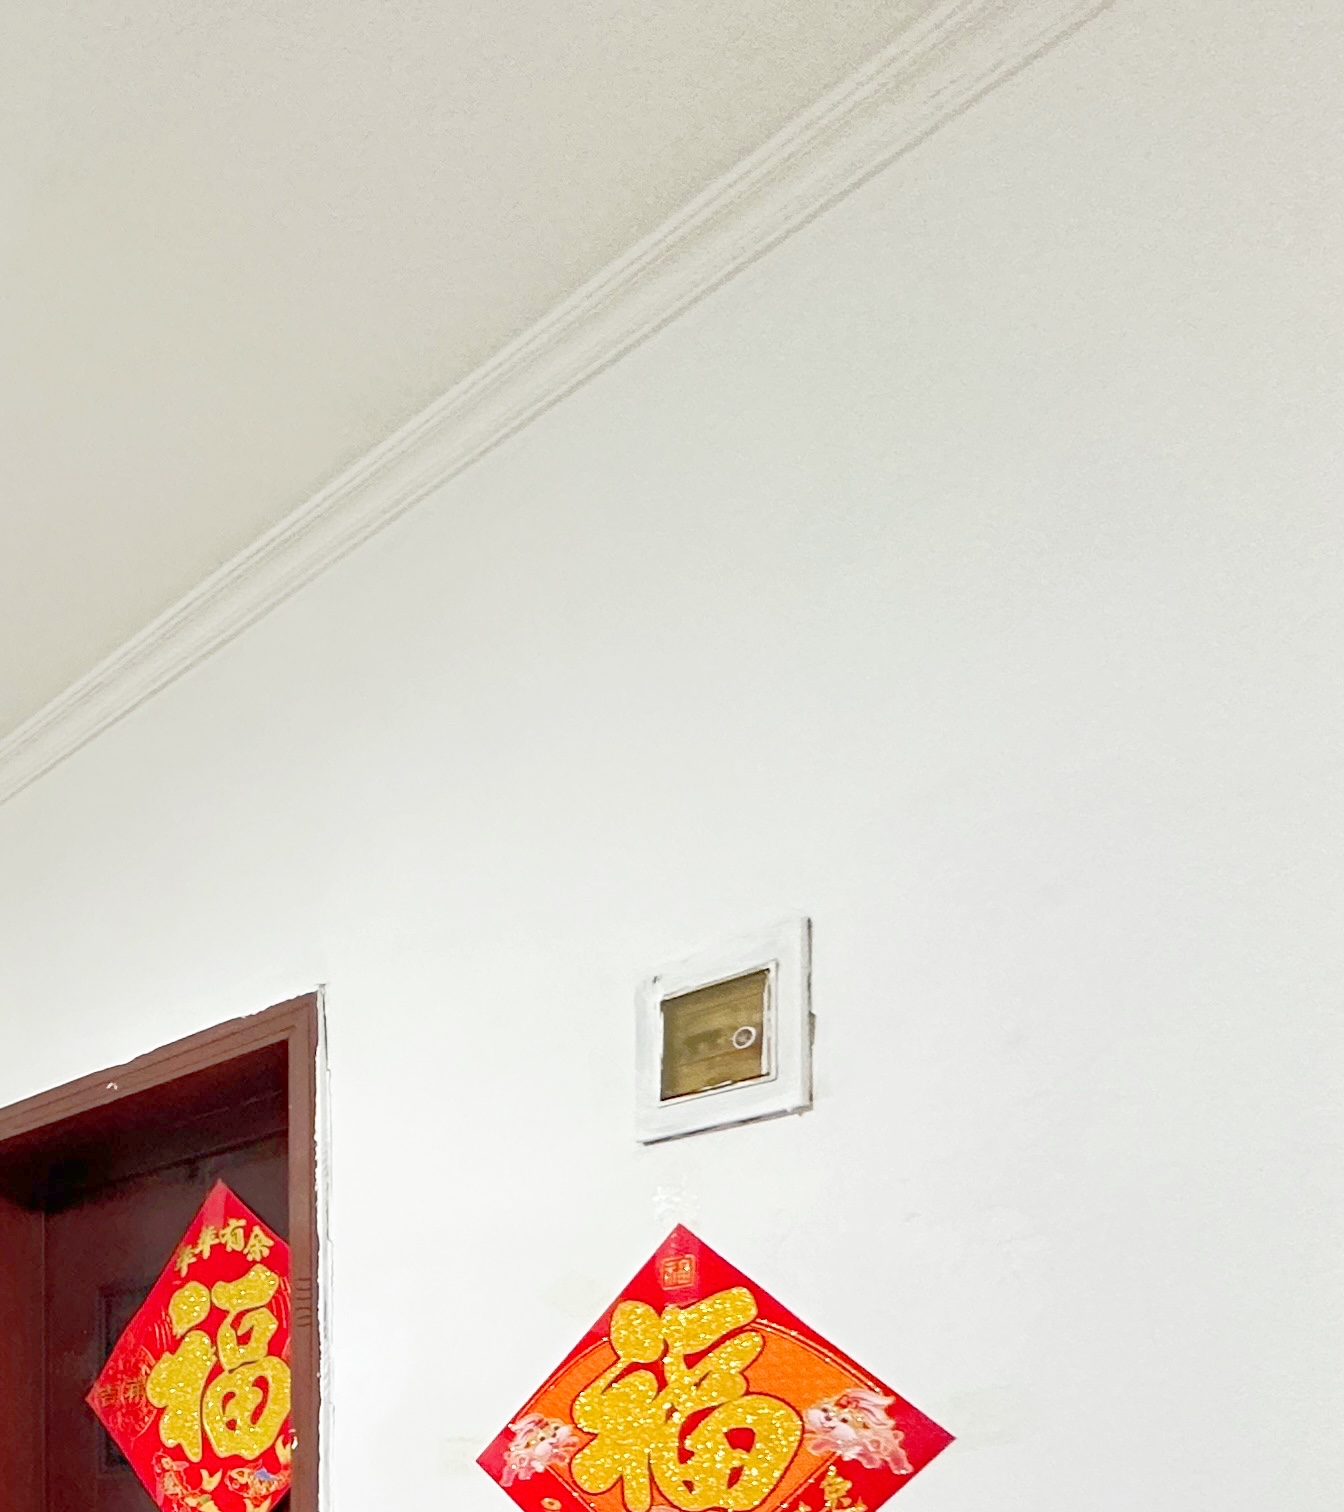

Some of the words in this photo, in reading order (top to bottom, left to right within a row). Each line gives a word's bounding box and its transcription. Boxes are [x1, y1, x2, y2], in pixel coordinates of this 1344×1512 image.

[173, 1216, 275, 1278] 年年有余
[146, 1263, 292, 1462] 福
